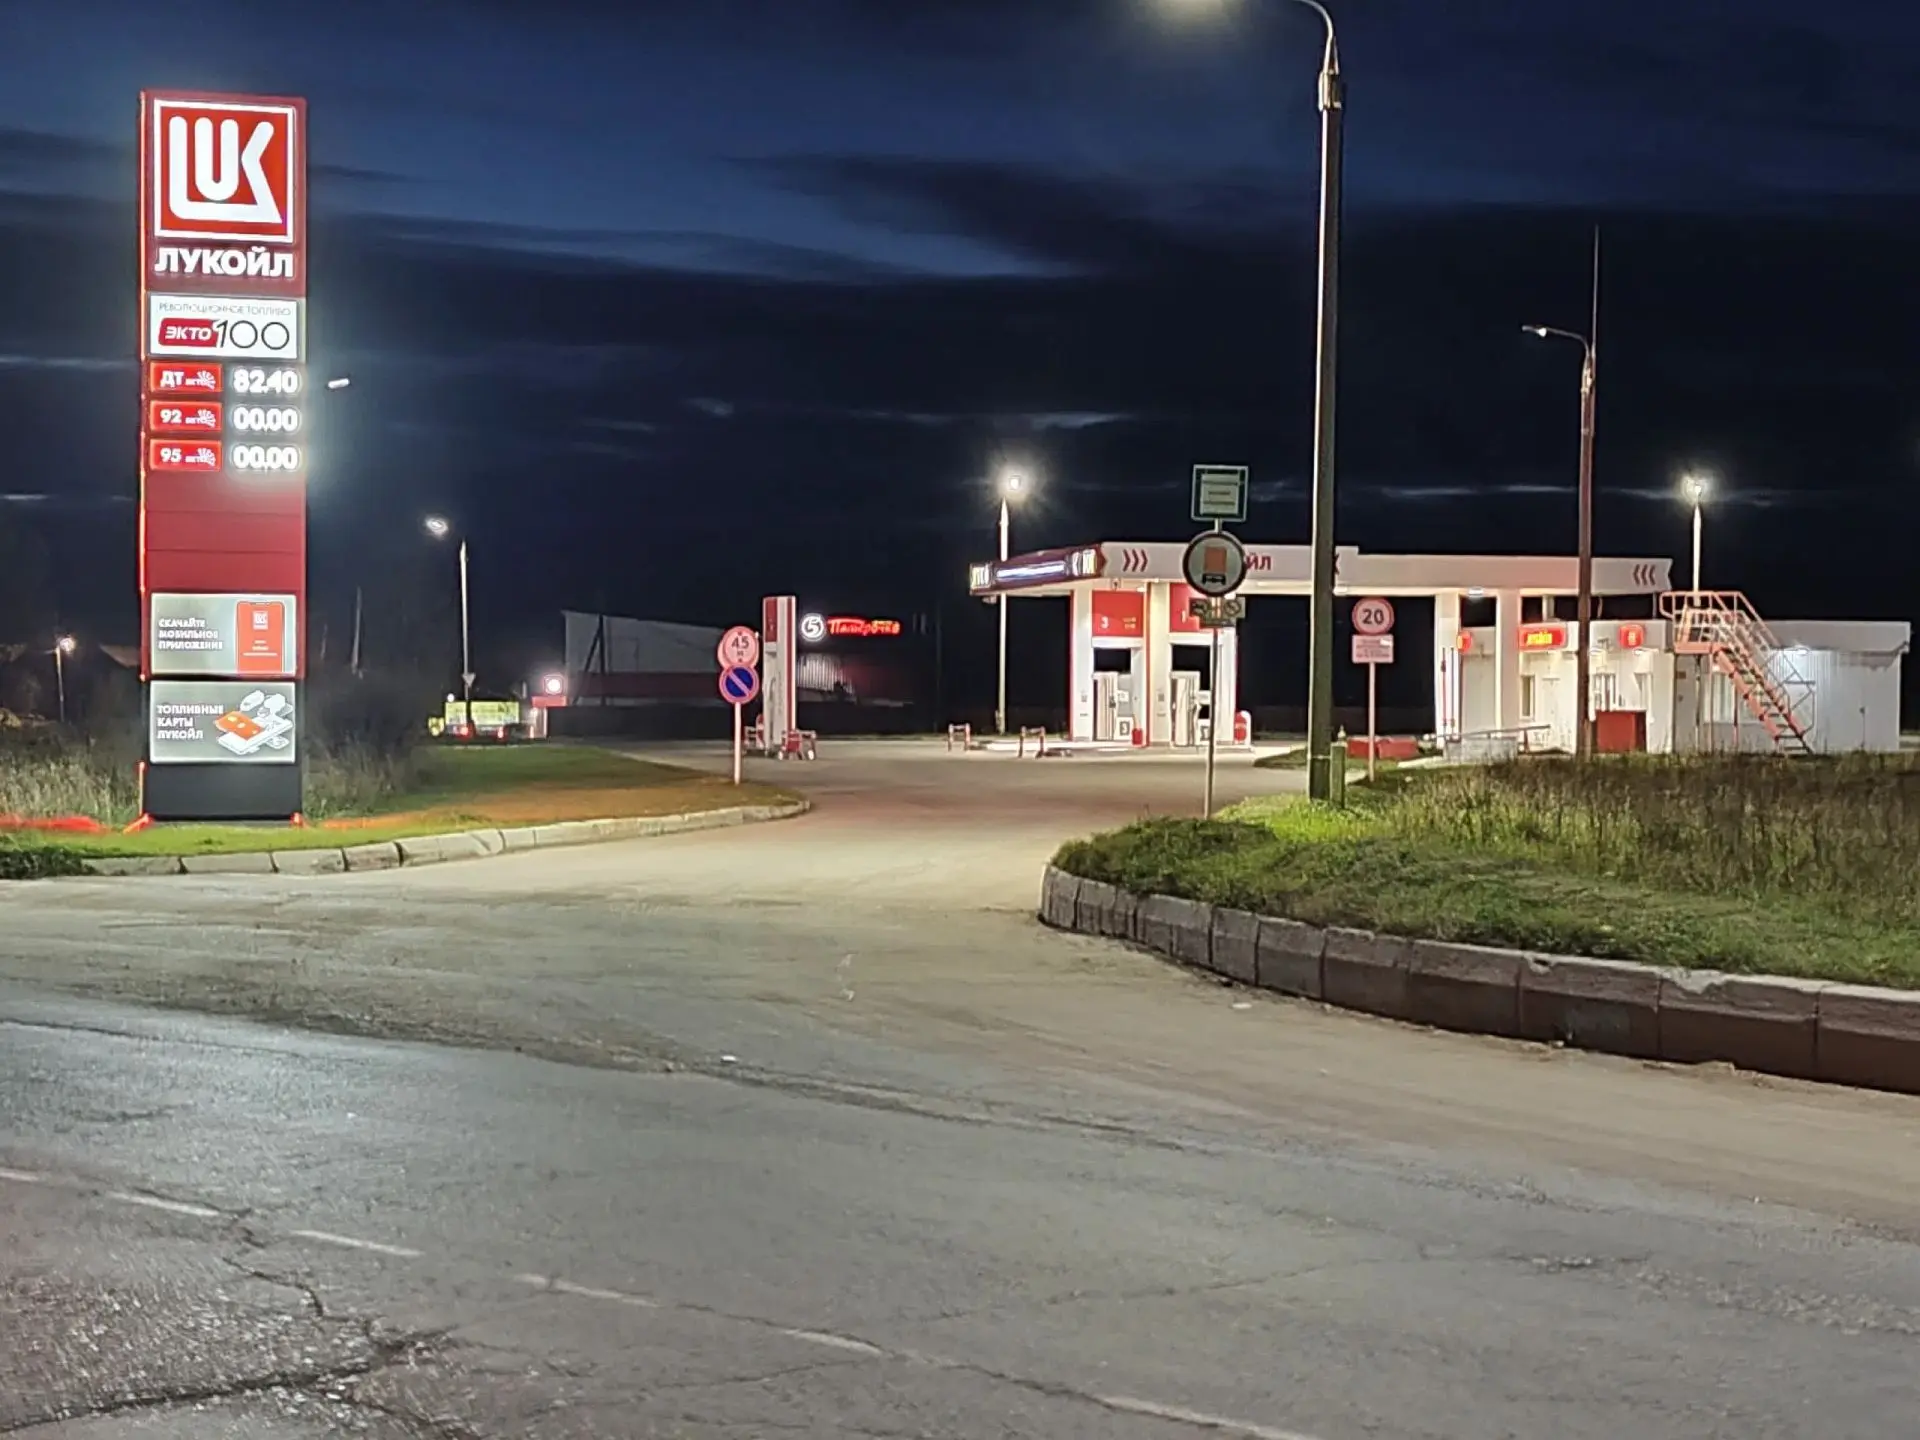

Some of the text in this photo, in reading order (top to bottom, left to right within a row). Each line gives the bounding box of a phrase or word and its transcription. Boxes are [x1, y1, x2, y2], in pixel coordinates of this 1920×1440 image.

[154, 246, 294, 277] ЛУКОЙЛ
[165, 320, 290, 350] ЭКТО 100
[160, 370, 184, 388] ДТ
[233, 369, 298, 394] 82.40
[160, 406, 298, 432] 92 00.00
[160, 445, 298, 471] 95 00.00
[158, 617, 206, 628] СКАЧАЙТЕ
[1362, 608, 1385, 625] 20
[158, 630, 218, 639] МОБИЛЬНОЕ
[158, 641, 223, 650] ПРИЛОЖЕНИЕ
[157, 705, 224, 714] ТОПЛИВНЫЕ
[157, 717, 194, 727] КАРТЫ
[157, 728, 204, 739] ЛУКОЙЛ
